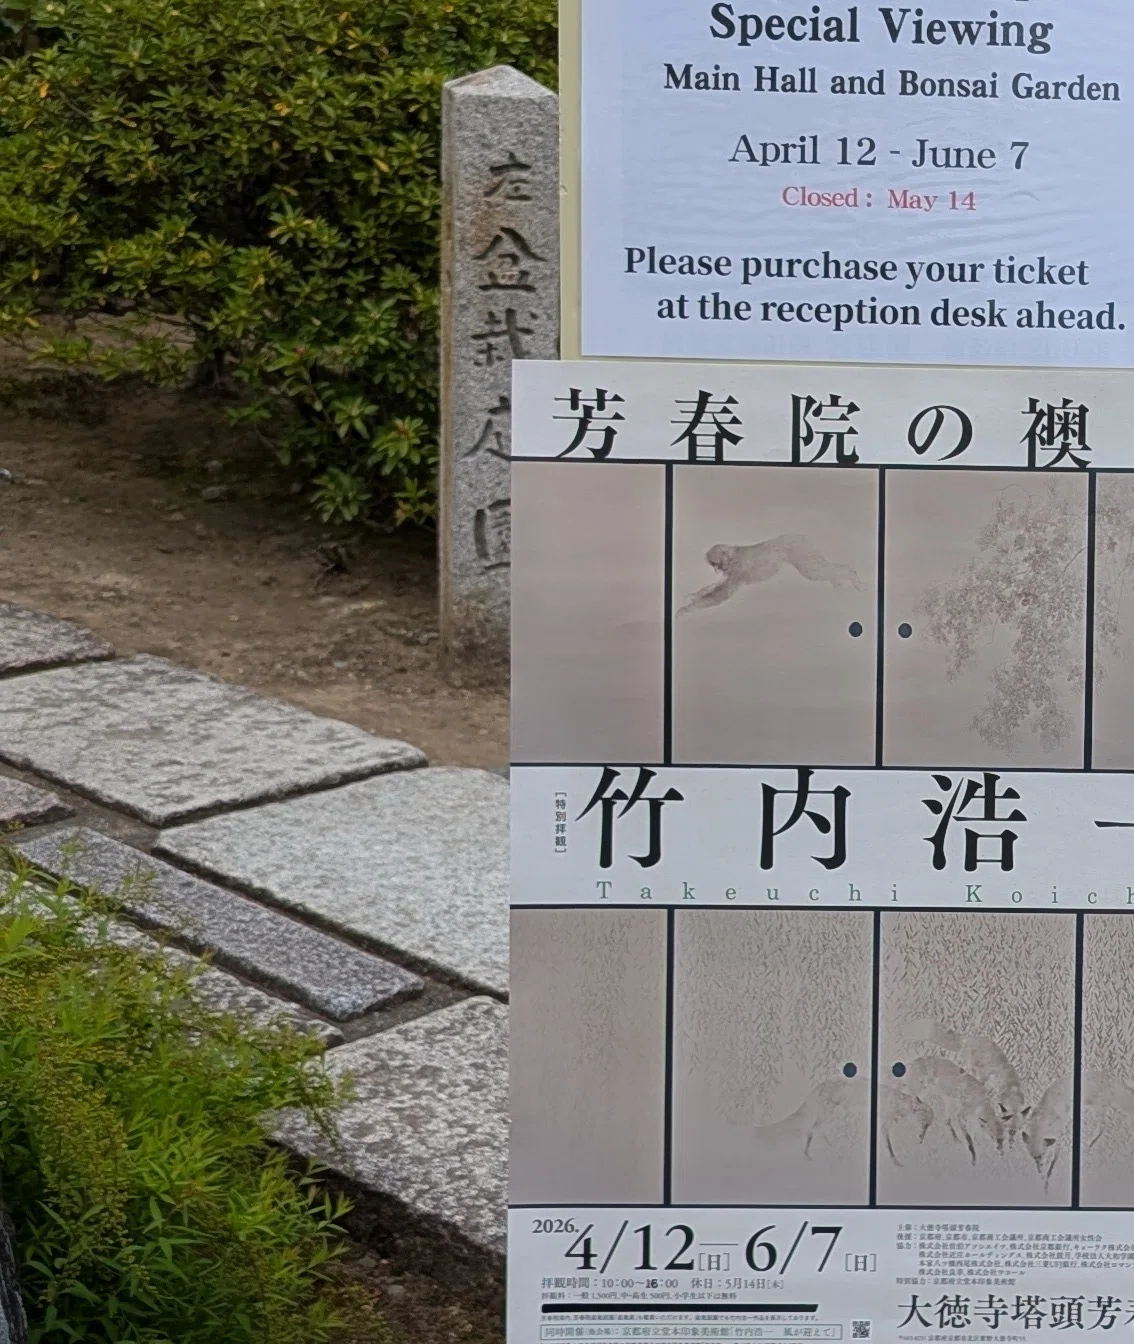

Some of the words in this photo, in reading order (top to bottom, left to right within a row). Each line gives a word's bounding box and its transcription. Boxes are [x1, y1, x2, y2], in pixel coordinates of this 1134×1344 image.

[710, 3, 860, 46] Special
[879, 8, 1053, 54] Viewing
[664, 63, 740, 91] Main
[754, 66, 817, 93] Hall
[831, 69, 885, 95] and
[899, 70, 998, 98] Bonsai
[1012, 73, 1120, 101] Garden
[728, 135, 820, 166] April
[837, 137, 876, 165] 12
[912, 139, 996, 168] June
[1011, 142, 1029, 169] 7
[888, 189, 938, 212] May
[949, 191, 976, 210] 14
[625, 246, 731, 276] Please
[741, 251, 897, 285] purchase
[905, 262, 984, 291] your
[993, 256, 1089, 285] ticket
[658, 295, 689, 319] at
[698, 292, 751, 320] the
[761, 297, 921, 331] reception
[931, 298, 1007, 327] desk
[1017, 300, 1125, 330] ahead.
[596, 881, 899, 902] Takeuchi
